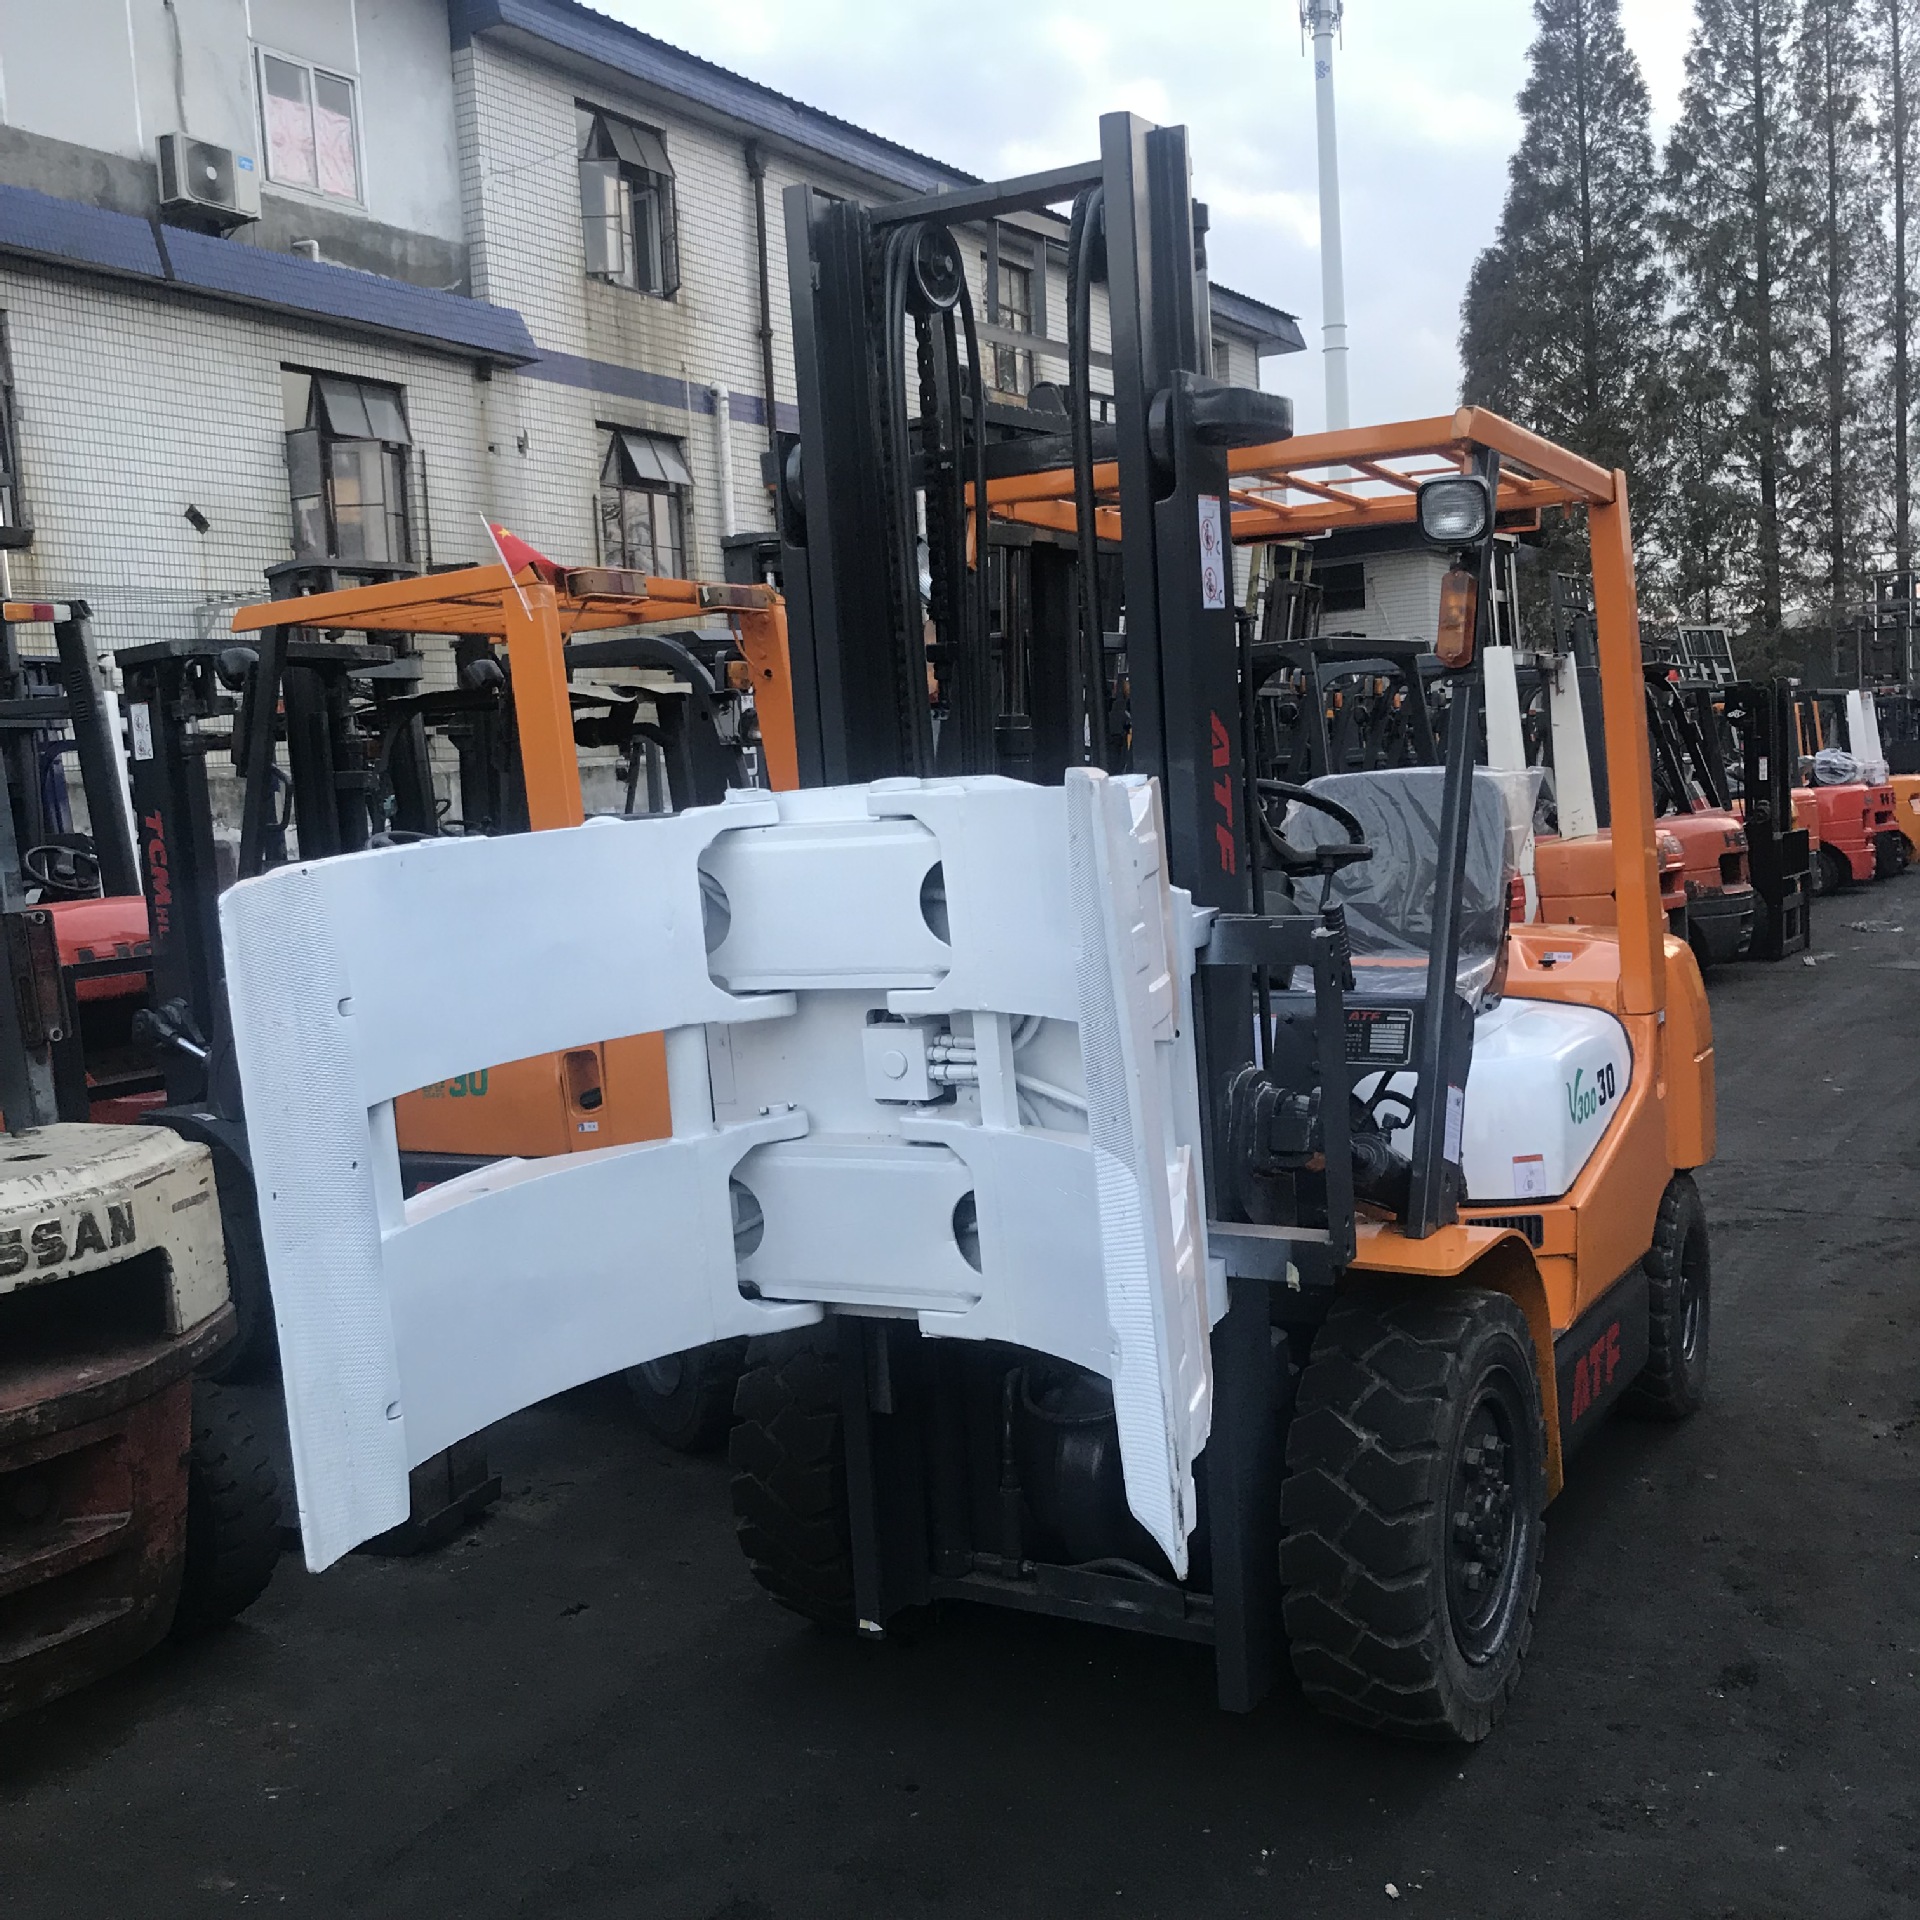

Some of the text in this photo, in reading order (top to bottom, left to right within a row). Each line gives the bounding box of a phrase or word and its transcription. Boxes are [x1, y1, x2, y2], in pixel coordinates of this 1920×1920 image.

[1211, 710, 1235, 876] ATF
[1349, 1011, 1382, 1021] ATF
[1566, 1062, 1615, 1124] V300 30
[0, 1199, 136, 1278] SSAN
[1571, 1321, 1620, 1424] ATF
